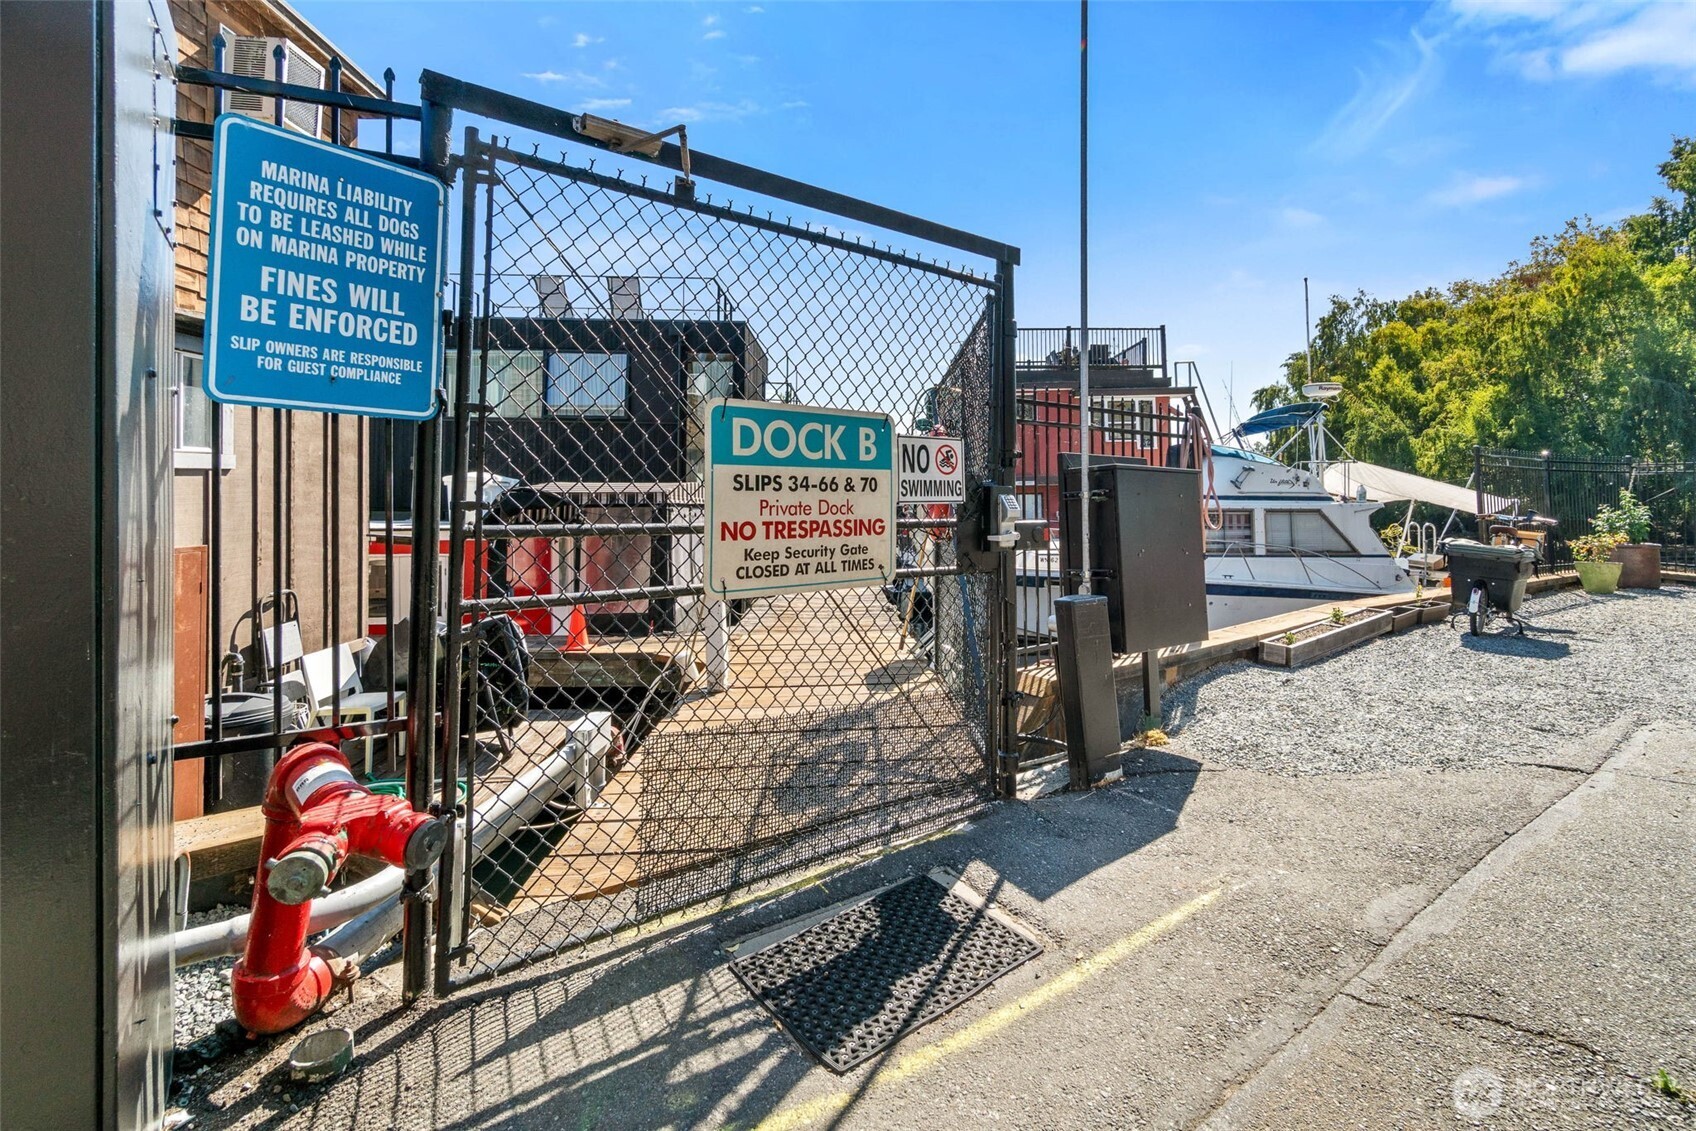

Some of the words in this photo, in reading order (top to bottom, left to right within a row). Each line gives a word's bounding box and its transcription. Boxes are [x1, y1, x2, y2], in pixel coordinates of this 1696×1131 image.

[262, 161, 329, 195] MARINA
[337, 181, 412, 216] LIABILITY
[250, 181, 337, 219] REQUIRES
[344, 207, 372, 228] ALL
[379, 215, 418, 240] DOGS
[237, 202, 261, 224] TO
[271, 210, 293, 232] BE
[301, 218, 373, 250] LEASHED
[381, 237, 426, 263] WHILE
[237, 227, 262, 249] ON
[272, 234, 338, 265] MARINA
[346, 251, 425, 283] PROPERTY
[261, 266, 337, 303] FINES
[349, 283, 405, 316] WILL
[241, 295, 276, 325] BE
[289, 303, 417, 346] ENFORCED
[231, 336, 260, 351] SLIP
[266, 340, 318, 359] OWNERS
[323, 348, 345, 363] ARE
[350, 352, 422, 373] RESPONSIBLE
[258, 356, 282, 371] FOR
[288, 360, 326, 375] GUEST
[331, 365, 401, 385] COMPLIANCE
[733, 418, 846, 460] DOCK
[859, 427, 877, 461] B
[902, 443, 930, 474] NO
[733, 474, 783, 492] SLIPS
[788, 475, 839, 492] 34-66
[844, 477, 856, 492] &
[860, 477, 878, 493] 70
[901, 479, 962, 497] SWIMMING
[760, 499, 812, 516] Private
[818, 498, 854, 516] Dock
[720, 521, 757, 541] NO
[762, 518, 886, 540] TRESPASSING
[736, 564, 790, 580] CLOSED
[794, 562, 811, 576] AT
[814, 560, 837, 574] ALL
[840, 558, 875, 572] TIMES
[744, 548, 780, 564] Keep
[785, 546, 836, 560] Security
[840, 543, 868, 556] Gate
